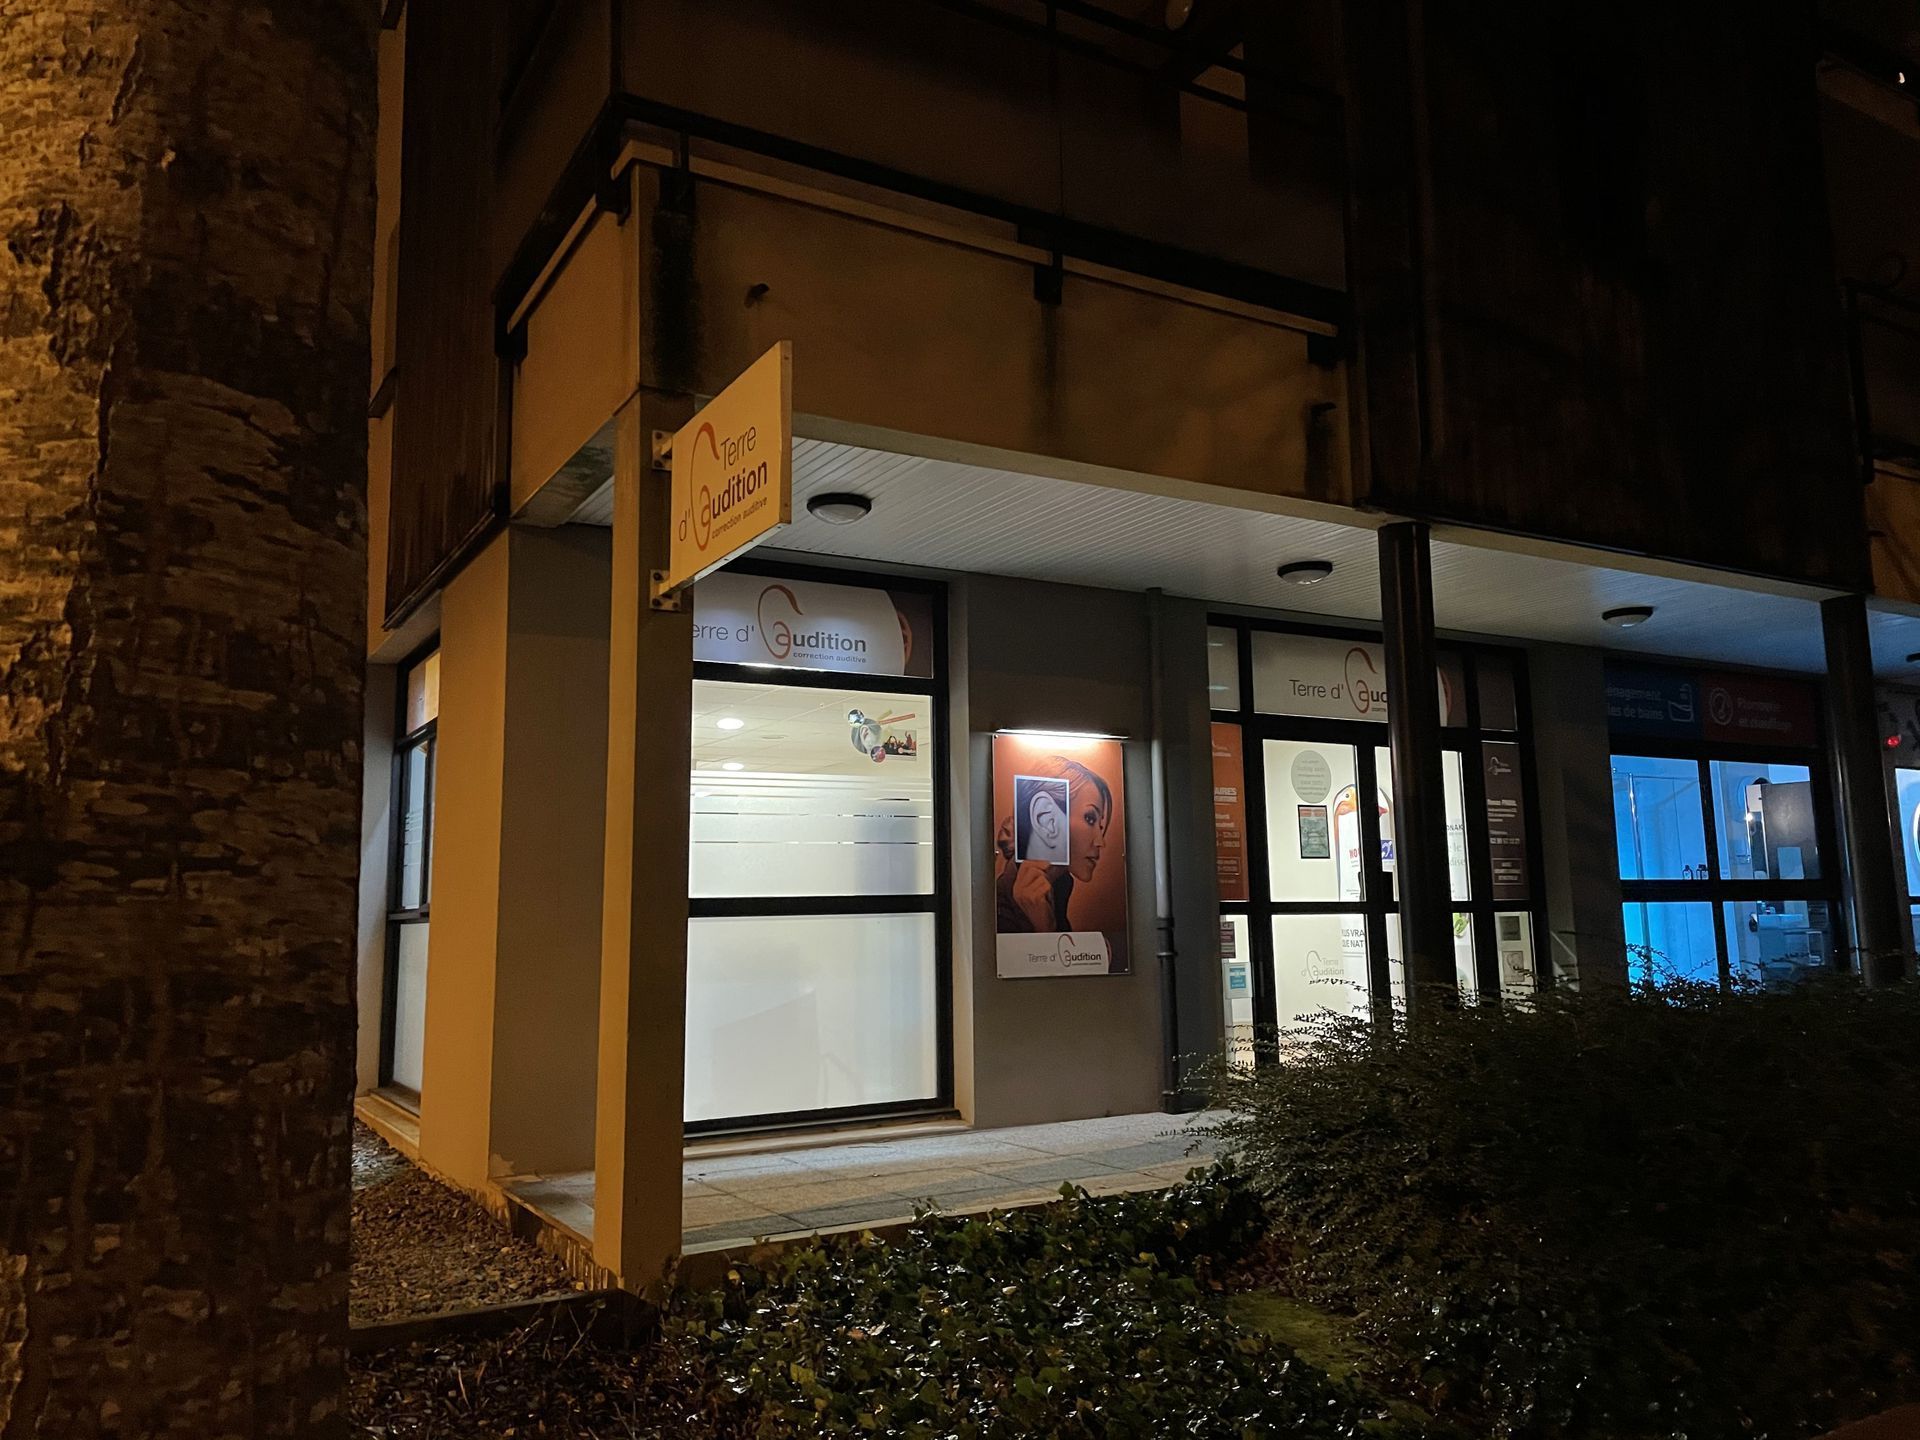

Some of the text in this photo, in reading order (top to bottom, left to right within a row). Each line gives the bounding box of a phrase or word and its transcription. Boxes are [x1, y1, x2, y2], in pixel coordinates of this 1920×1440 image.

[720, 426, 757, 471] Terre
[711, 497, 768, 539] correction auditive
[693, 623, 729, 641] erre
[792, 651, 867, 664] correction auditive
[1288, 679, 1327, 698] Terre
